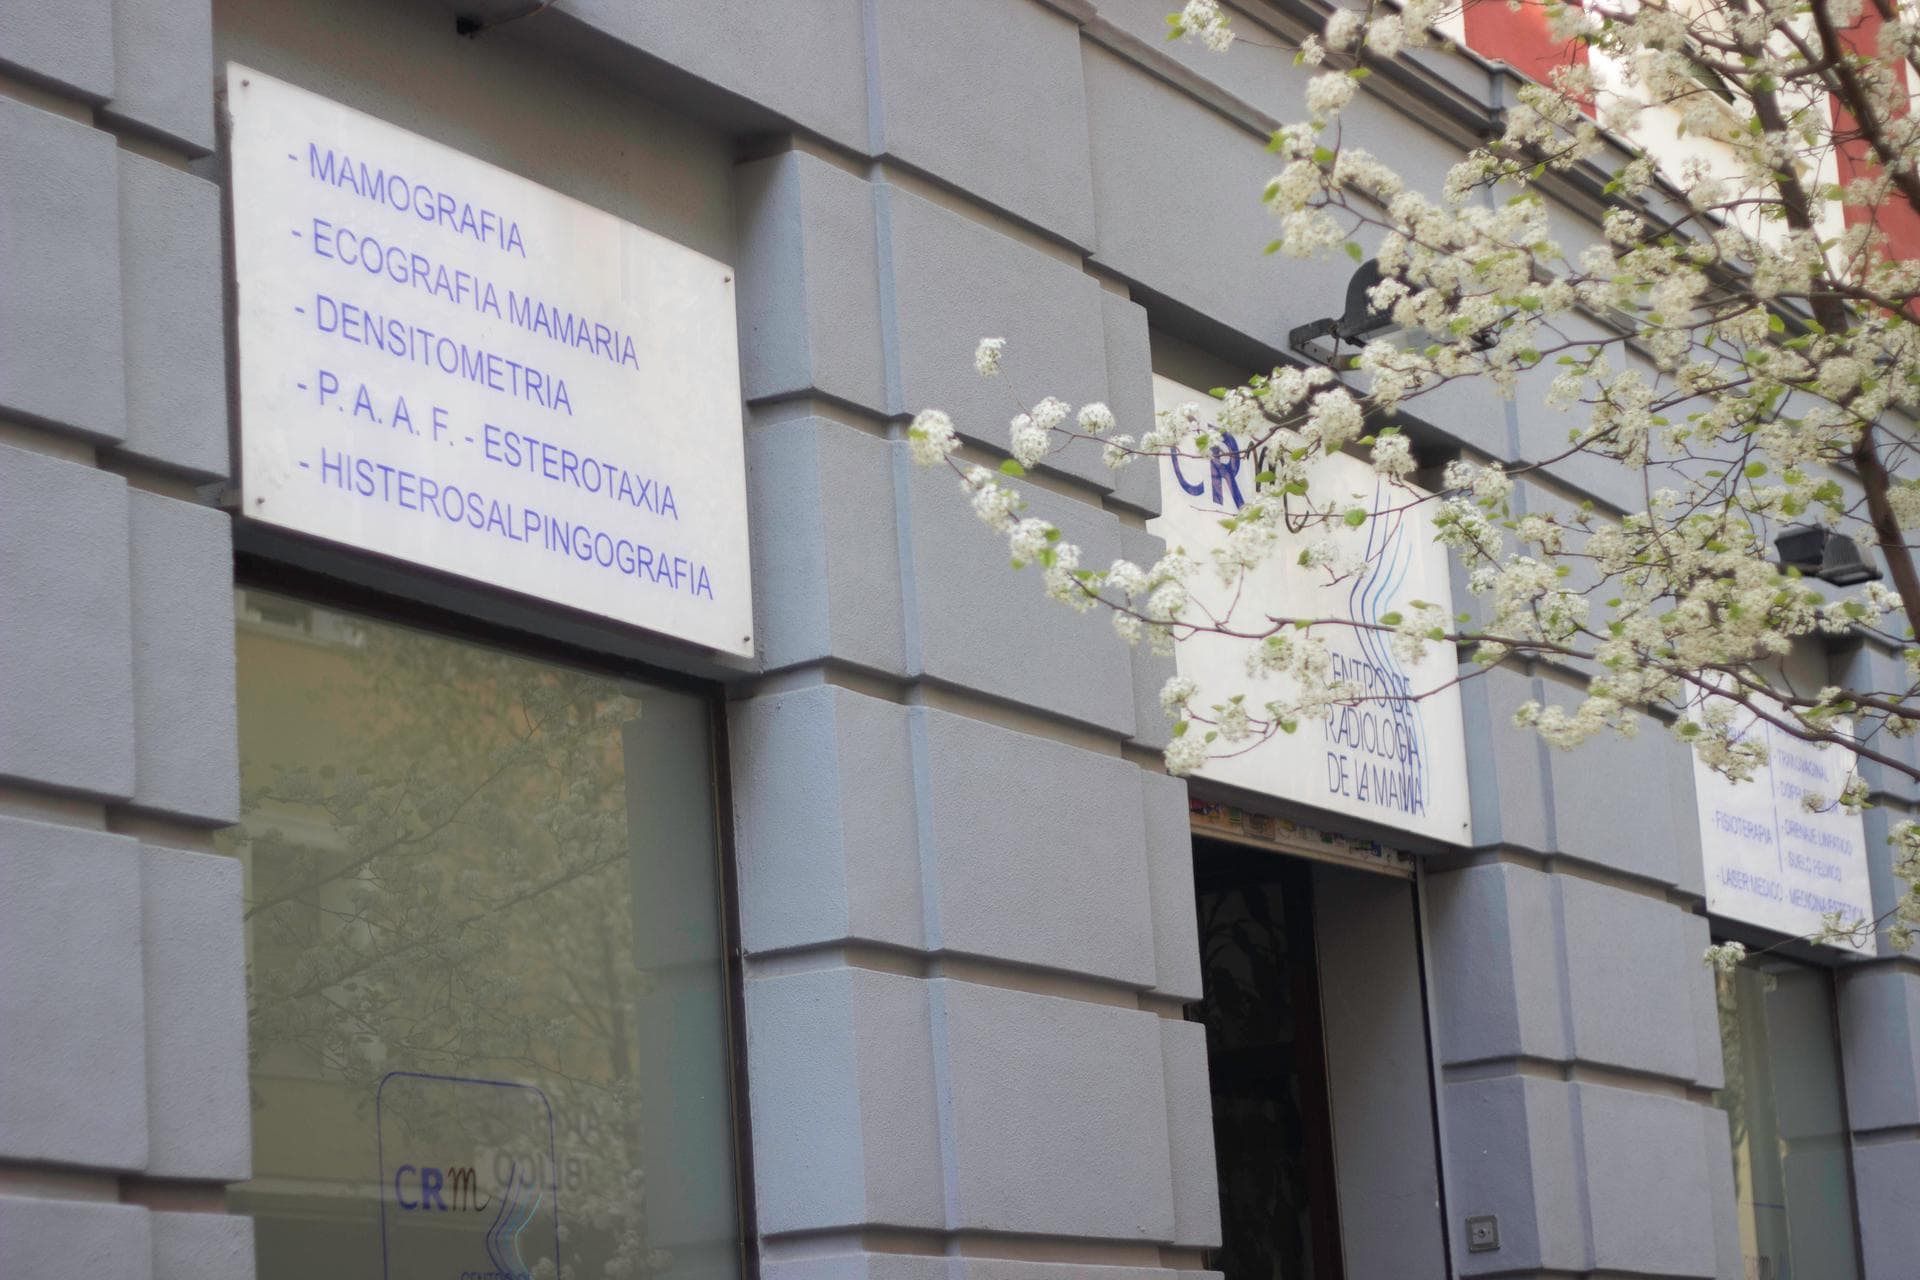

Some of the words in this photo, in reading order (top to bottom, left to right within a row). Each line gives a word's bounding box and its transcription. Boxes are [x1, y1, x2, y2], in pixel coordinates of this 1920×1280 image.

[308, 142, 527, 258] MAMOGRAFIA
[312, 216, 501, 318] ECOGRAFIA
[507, 289, 639, 370] MAMARIA
[315, 293, 574, 417] DENSITOMETRIA
[321, 447, 715, 601] HISTEROSALPINGOGRAFIA
[483, 423, 679, 521] ESTEROTAXIA
[1391, 671, 1414, 718] DE
[1327, 751, 1351, 798] DE
[1355, 758, 1371, 803] LA
[1372, 765, 1426, 818] MAMA
[1715, 810, 1774, 846] FISIOTERAPIA
